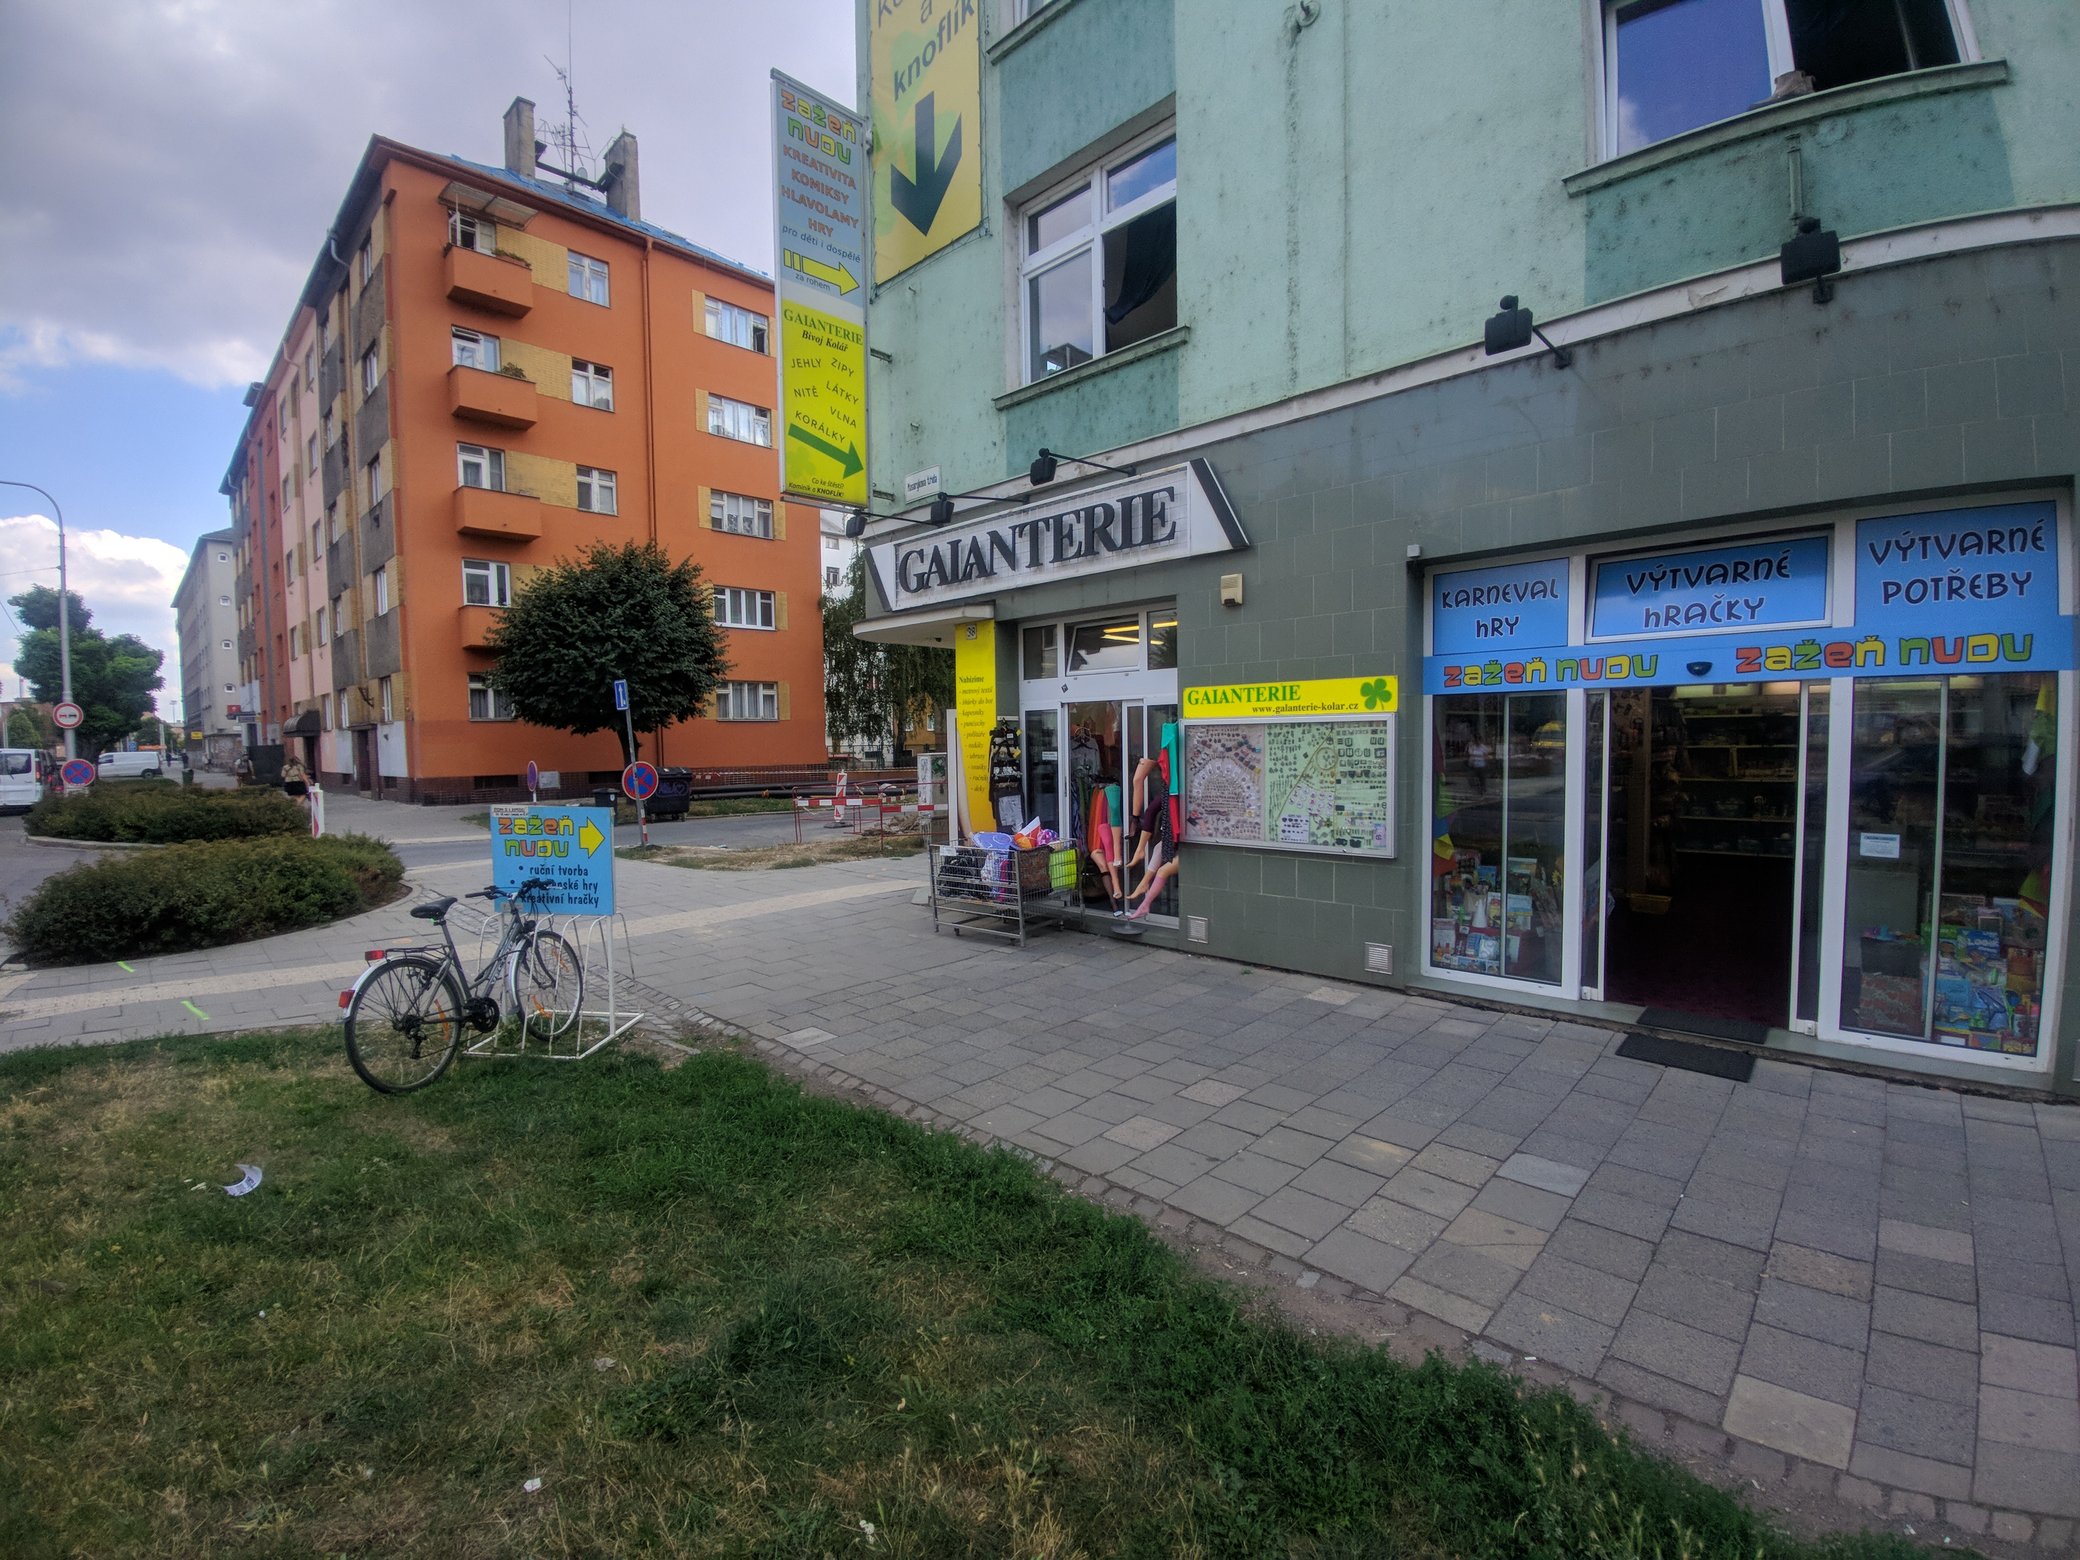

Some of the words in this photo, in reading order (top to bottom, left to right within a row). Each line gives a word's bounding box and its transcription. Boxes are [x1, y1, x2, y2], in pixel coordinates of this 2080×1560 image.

[782, 143, 857, 190] KREATIVITA
[791, 167, 850, 205] KOMIKSY
[780, 184, 860, 229] HLAVOLAMY
[807, 216, 834, 238] HRY
[782, 224, 798, 238] pro
[800, 232, 818, 247] děti
[826, 243, 861, 263] dospělé
[795, 273, 805, 283] za
[806, 276, 831, 292] rohem
[783, 308, 864, 346] GALANTERIE
[801, 329, 824, 346] Bivoj
[825, 337, 849, 352] Kolář
[791, 357, 822, 369] JEHLY
[830, 356, 855, 378] ZIPY
[826, 380, 860, 406] LÁTKY
[795, 409, 846, 444] KORÁLKY
[830, 406, 857, 429] VLNA
[898, 485, 1178, 594] GALANTERIE
[1867, 517, 2047, 567] VÝTVARNÉ
[1625, 549, 1791, 596] VÝTVARNÉ
[1881, 567, 2033, 606] POTŘEBY
[1187, 684, 1301, 707] GALANTERIE
[1251, 701, 1359, 715] www.galanterie-kolar.cz
[529, 864, 555, 876] ruční
[558, 864, 589, 876] tvorba
[582, 878, 599, 894] hry
[567, 893, 600, 909] hračky
